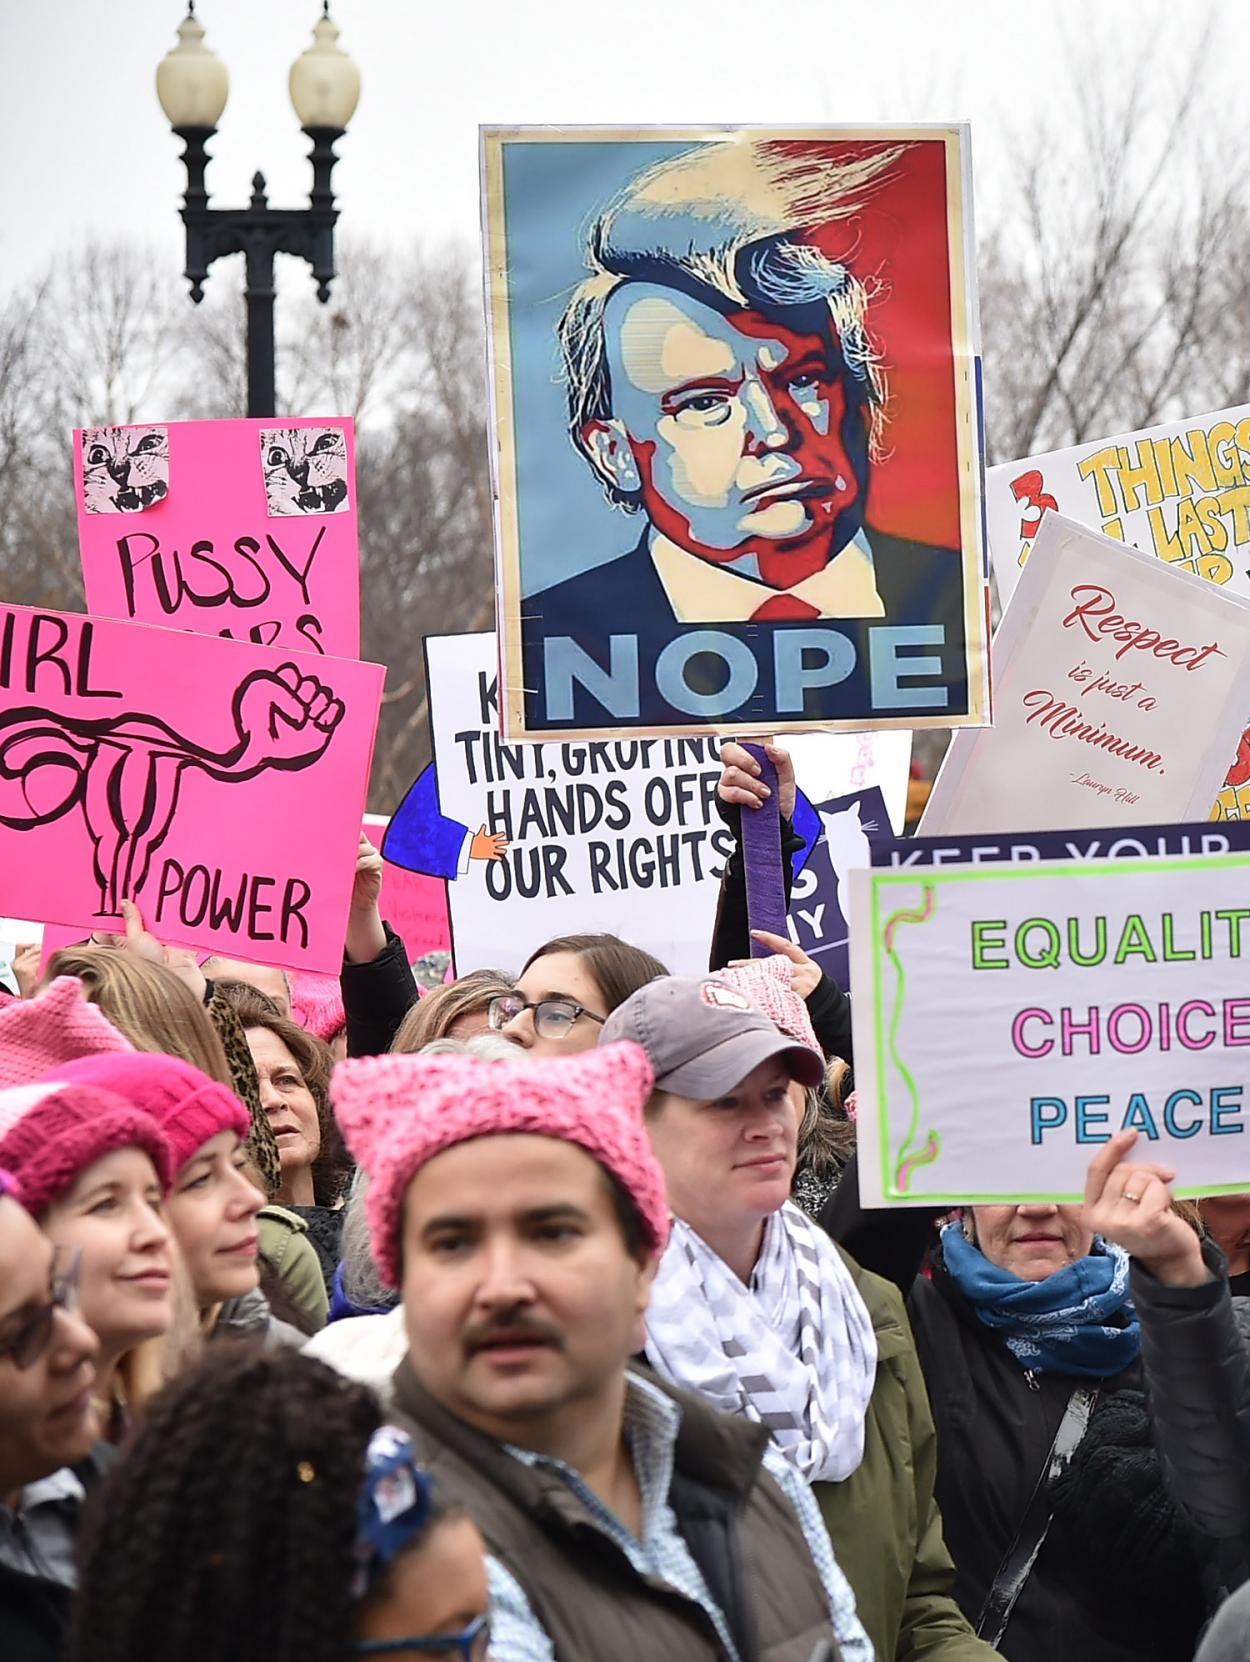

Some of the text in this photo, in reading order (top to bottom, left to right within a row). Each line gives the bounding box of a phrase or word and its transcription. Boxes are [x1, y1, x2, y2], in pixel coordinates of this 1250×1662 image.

[116, 526, 327, 618] PUSSY
[0, 612, 124, 699] IRL
[1062, 584, 1229, 671] Respect
[544, 623, 949, 721] NOPE
[1067, 660, 1159, 712] is just a
[454, 730, 557, 784] TINY,
[1023, 690, 1166, 775] Minimum.
[487, 779, 631, 842] HANDS
[644, 771, 723, 827] OFF
[1113, 787, 1141, 804] Hill
[484, 844, 576, 902] OUR
[588, 828, 736, 894] RIGHTS
[154, 858, 312, 948] POWER
[1029, 1086, 1244, 1145] PEACE
